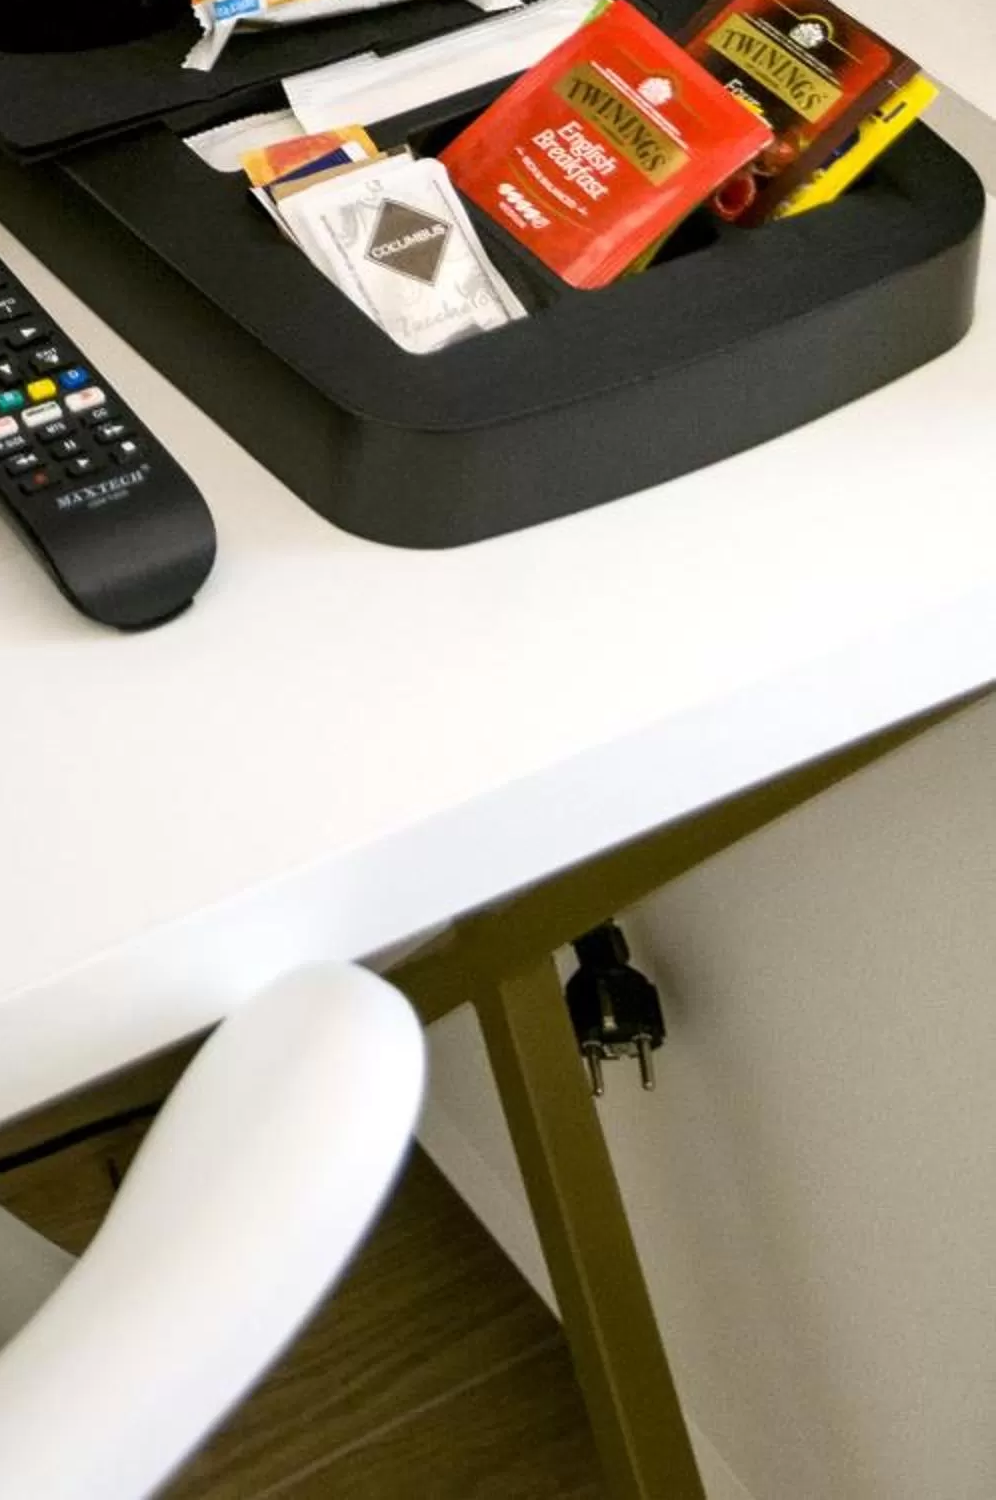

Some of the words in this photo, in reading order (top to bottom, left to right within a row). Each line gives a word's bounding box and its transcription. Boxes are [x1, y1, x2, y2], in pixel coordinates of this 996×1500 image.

[720, 29, 822, 112] TWININGS
[558, 120, 617, 175] English
[565, 77, 668, 172] TWININGS
[532, 128, 609, 201] Breakfast
[370, 223, 447, 259] COLUMBUS
[56, 469, 144, 510] MAXTECH
